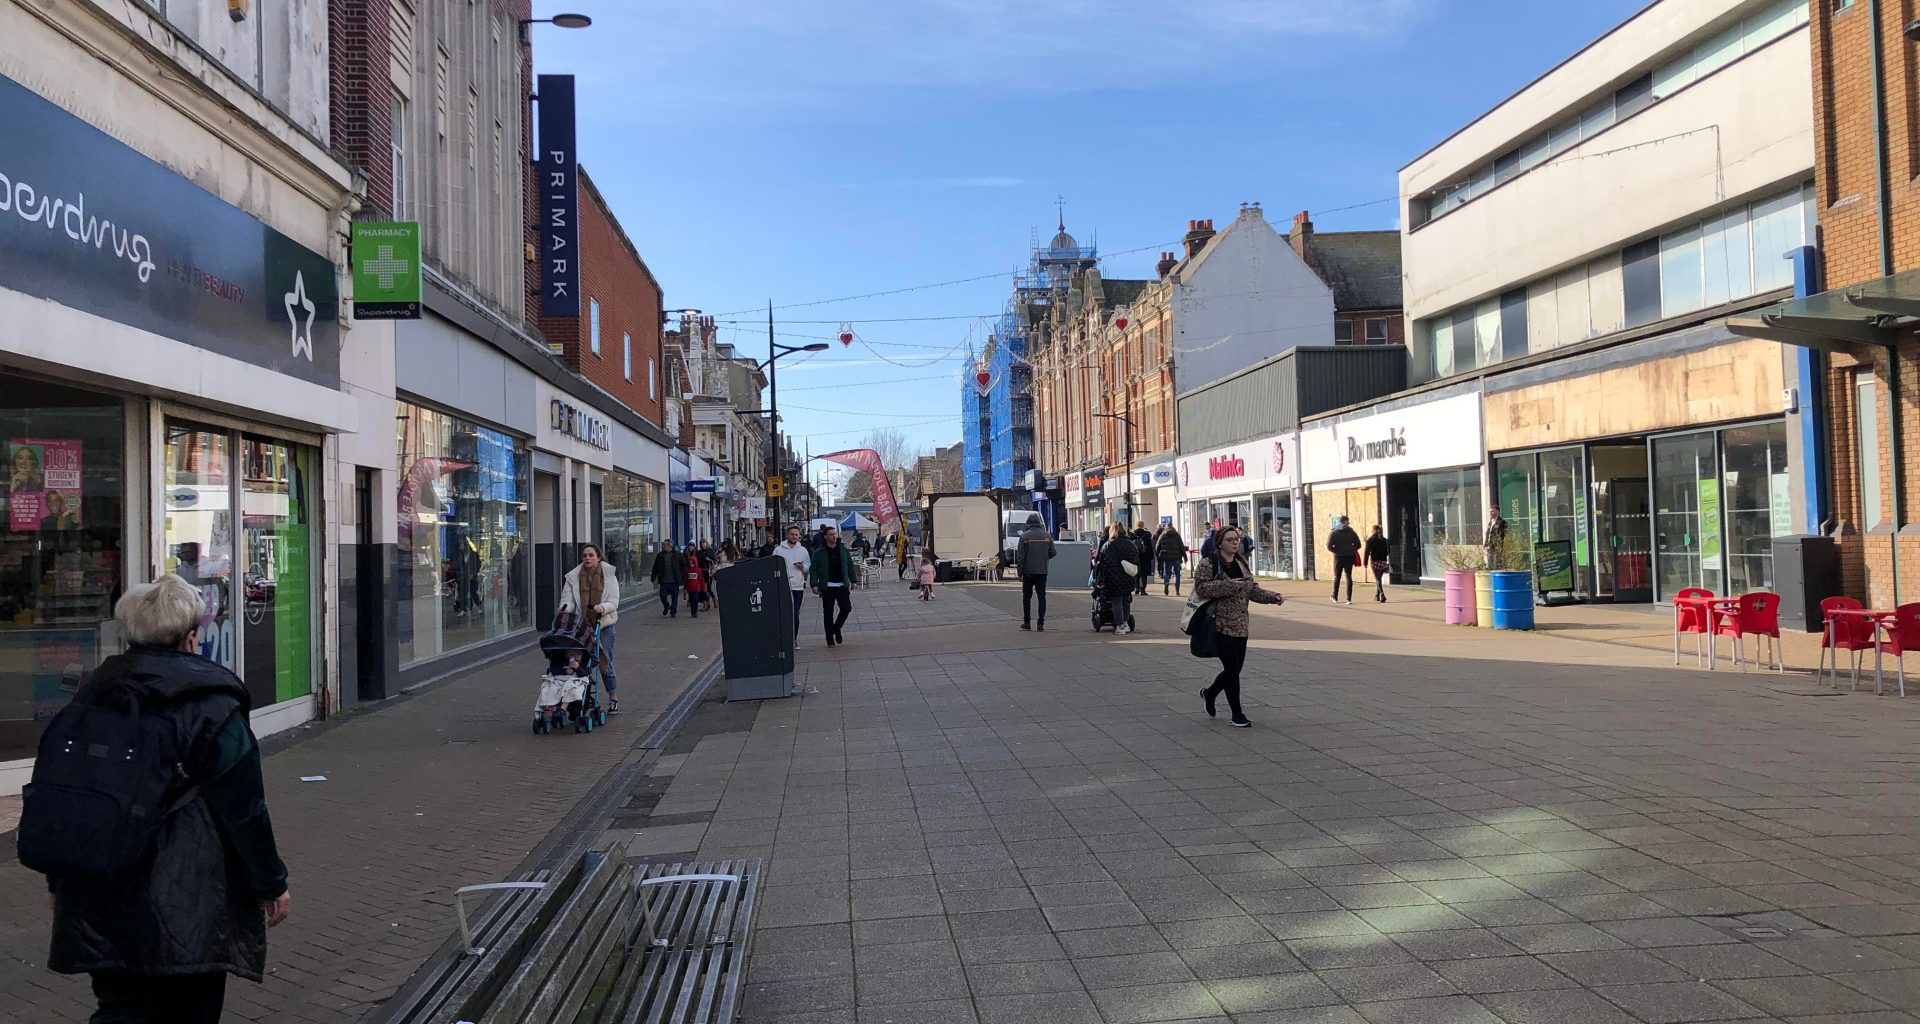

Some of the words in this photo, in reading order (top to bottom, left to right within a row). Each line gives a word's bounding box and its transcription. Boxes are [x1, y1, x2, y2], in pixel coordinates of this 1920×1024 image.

[357, 228, 412, 237] PHARMACY
[551, 150, 567, 298] PRIMARK
[551, 399, 612, 451] PRIMARK
[47, 471, 78, 480] STUDENT
[1208, 454, 1244, 480] Malinka
[877, 493, 893, 516] BAR
[1511, 498, 1520, 526] Lenses
